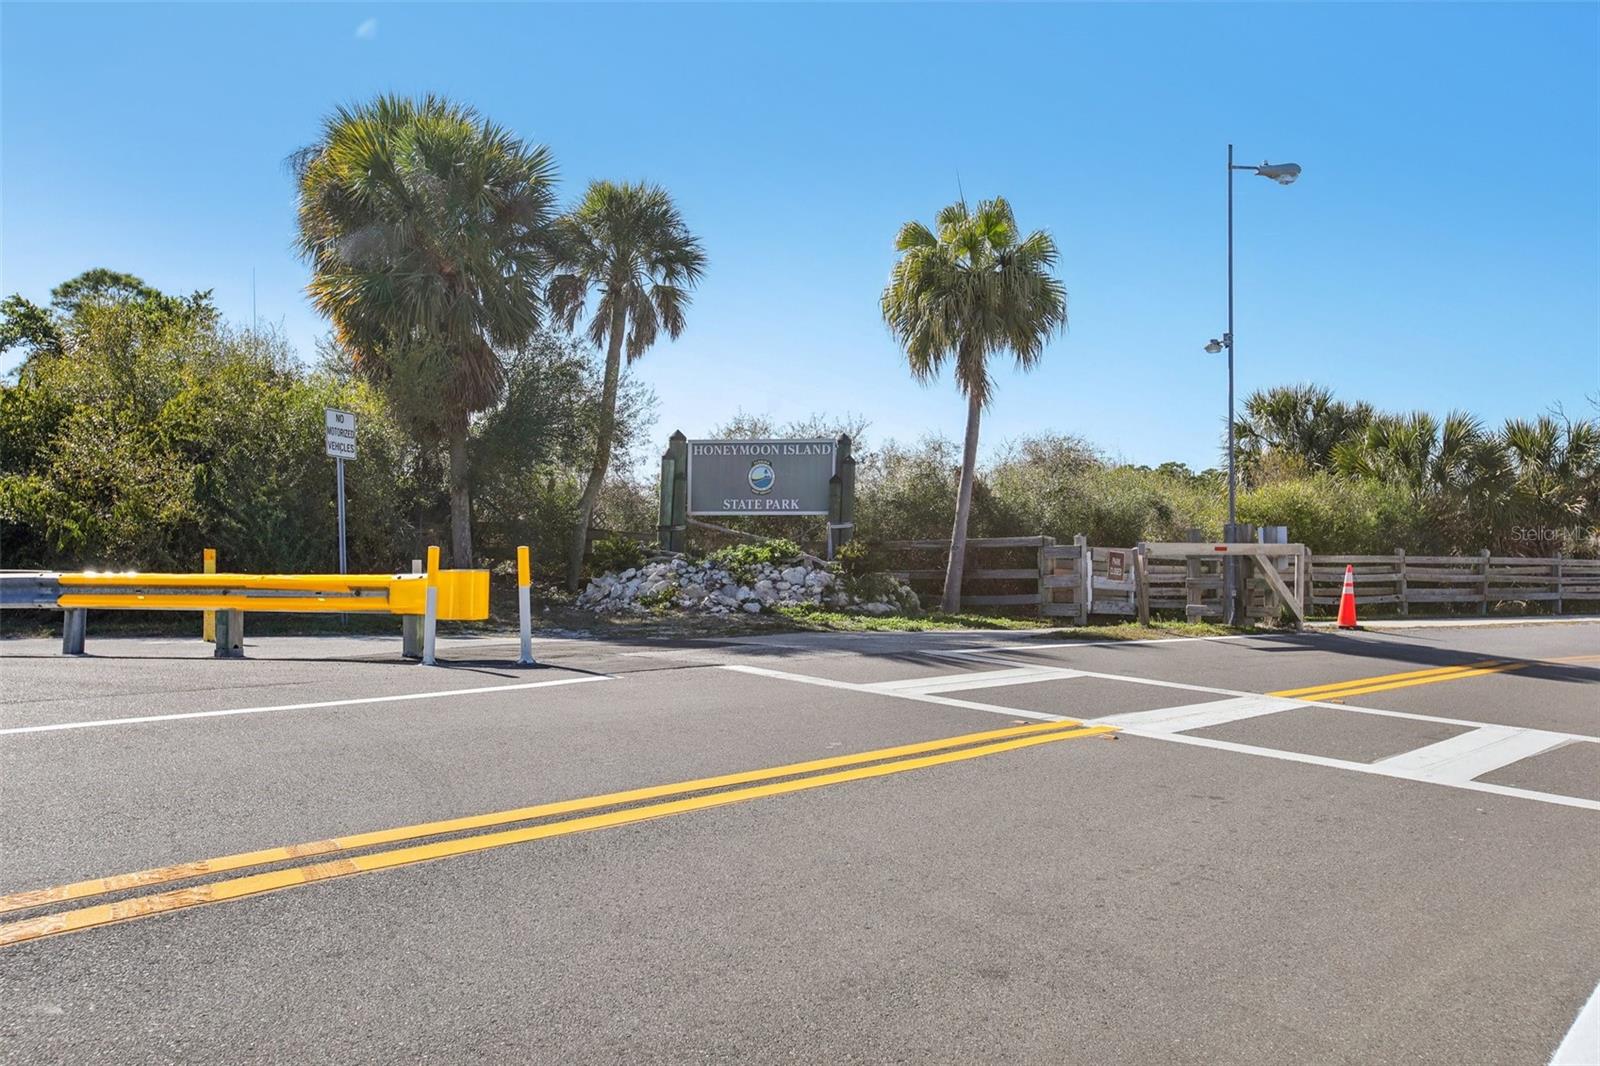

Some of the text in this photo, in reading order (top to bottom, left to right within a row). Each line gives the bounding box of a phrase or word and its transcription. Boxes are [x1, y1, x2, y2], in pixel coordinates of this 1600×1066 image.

[336, 414, 344, 423] NO
[327, 426, 354, 438] MOTORIZED
[328, 442, 354, 454] VEHICLES
[693, 444, 831, 456] HONEYMOON ISLAND
[723, 499, 800, 510] STATE PARK
